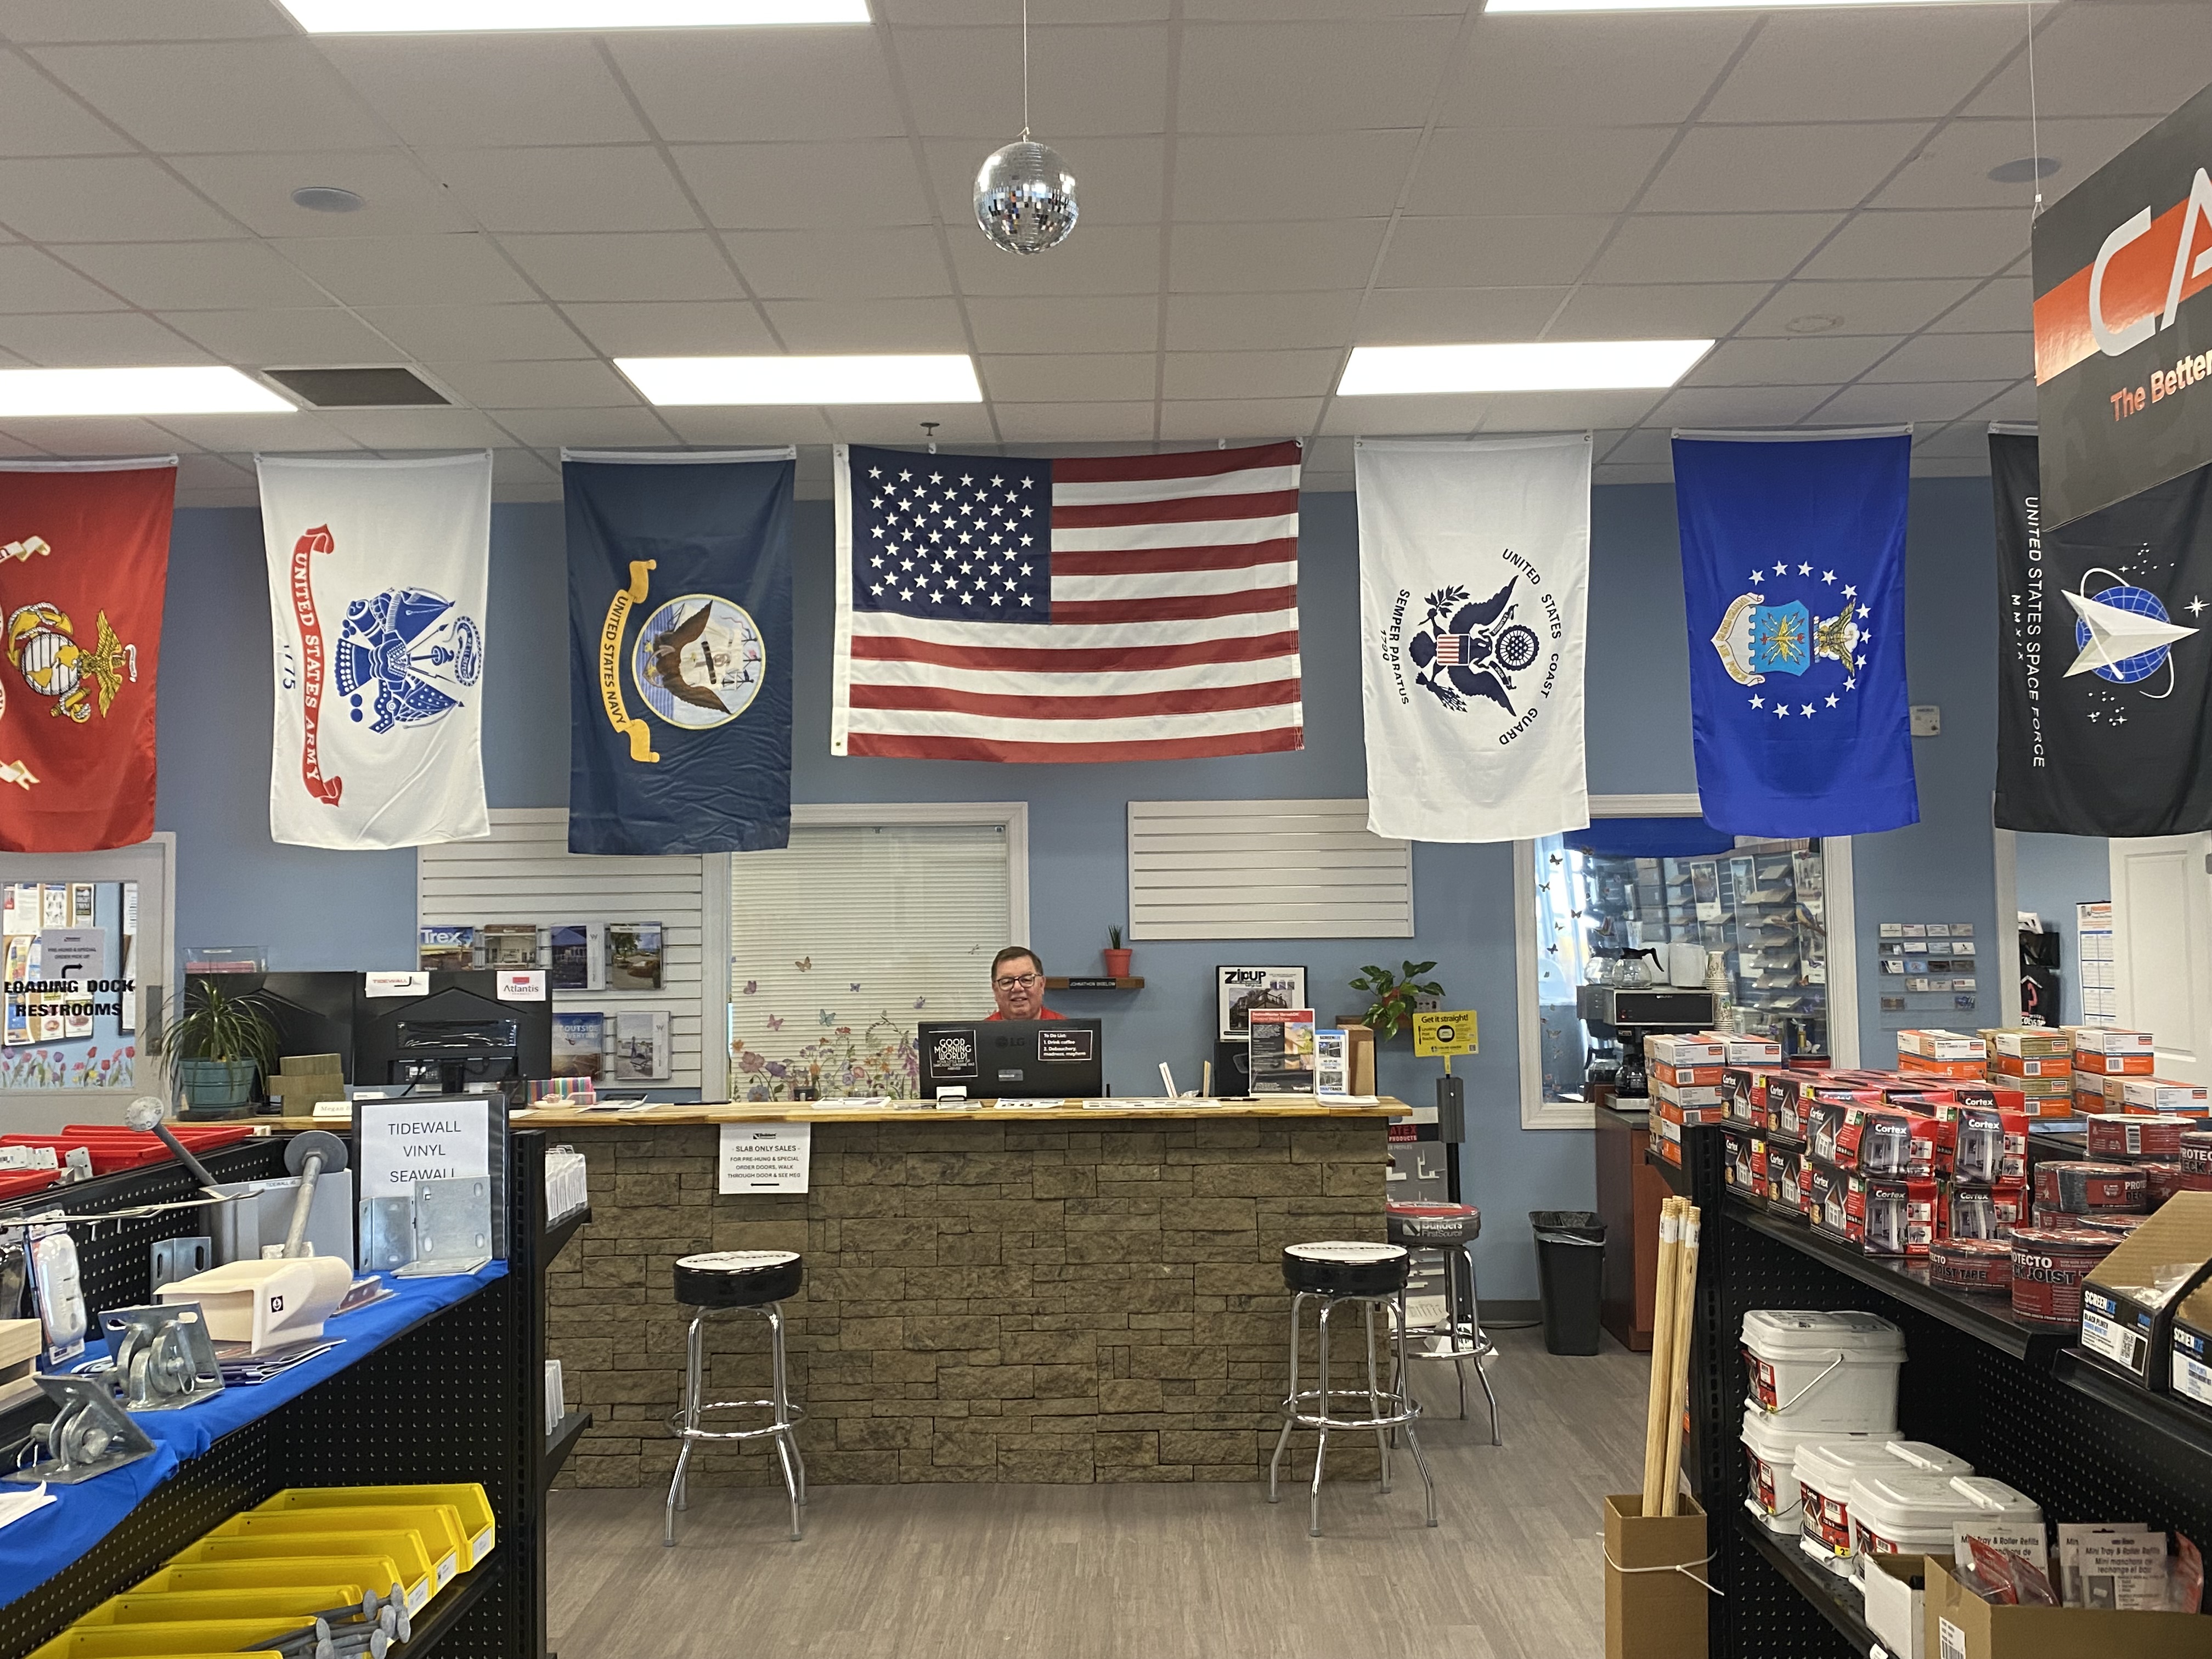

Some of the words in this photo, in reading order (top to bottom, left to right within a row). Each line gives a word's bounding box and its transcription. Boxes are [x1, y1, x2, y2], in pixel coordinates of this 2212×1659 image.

[2110, 387, 2145, 422] The
[2151, 349, 2212, 404] Better
[2025, 496, 2041, 562] UNITED
[1503, 549, 1541, 585] UNITED
[294, 552, 314, 627] UNITED
[2027, 568, 2042, 635] STATES
[604, 596, 628, 641] UNITED
[1389, 589, 1410, 641] SEMPER
[1542, 594, 1561, 639] STATES
[1380, 629, 1390, 662] 1790
[304, 635, 320, 709] STATES
[603, 644, 616, 689] STATES
[2026, 642, 2041, 700] SPACE
[1389, 645, 1409, 705] PARATUS
[1540, 653, 1559, 698] COAST
[606, 691, 627, 725] NAVY
[1499, 707, 1538, 745] GUARD
[2032, 707, 2045, 768] FORCE
[304, 718, 321, 781] ARMY
[421, 929, 462, 944] Trex
[4, 980, 78, 994] LOADING
[87, 979, 136, 993] DOCK
[504, 984, 539, 992] Atlantis
[15, 1003, 123, 1017] RESTROOMS
[1441, 1014, 1469, 1023] straight!
[939, 1038, 965, 1047] GOOD
[1010, 1036, 1025, 1047] LG
[934, 1045, 972, 1053] MORNING
[939, 1052, 967, 1060] WORLD!
[1723, 1075, 1736, 1086] Cortex
[1770, 1085, 1784, 1097] Cortex
[1810, 1107, 1825, 1121] Cortex
[388, 1121, 461, 1135] TIDEWALL
[1875, 1124, 1906, 1135] Cortex
[1969, 1120, 2000, 1129] Cortex
[403, 1144, 445, 1157] VINYL
[1726, 1139, 1738, 1152] Cortex
[1770, 1153, 1784, 1166] Cortex
[390, 1168, 454, 1182] SEAWALL
[1814, 1173, 1828, 1188] Cortex
[1876, 1190, 1905, 1199] Cortex
[1422, 1221, 1463, 1229] Builders
[1960, 1269, 1987, 1280] TAPE
[2028, 1267, 2076, 1284] JOIST
[2020, 1537, 2039, 1545] Refills
[2101, 1547, 2114, 1555] Tray
[2097, 1566, 2129, 1575] rechange
